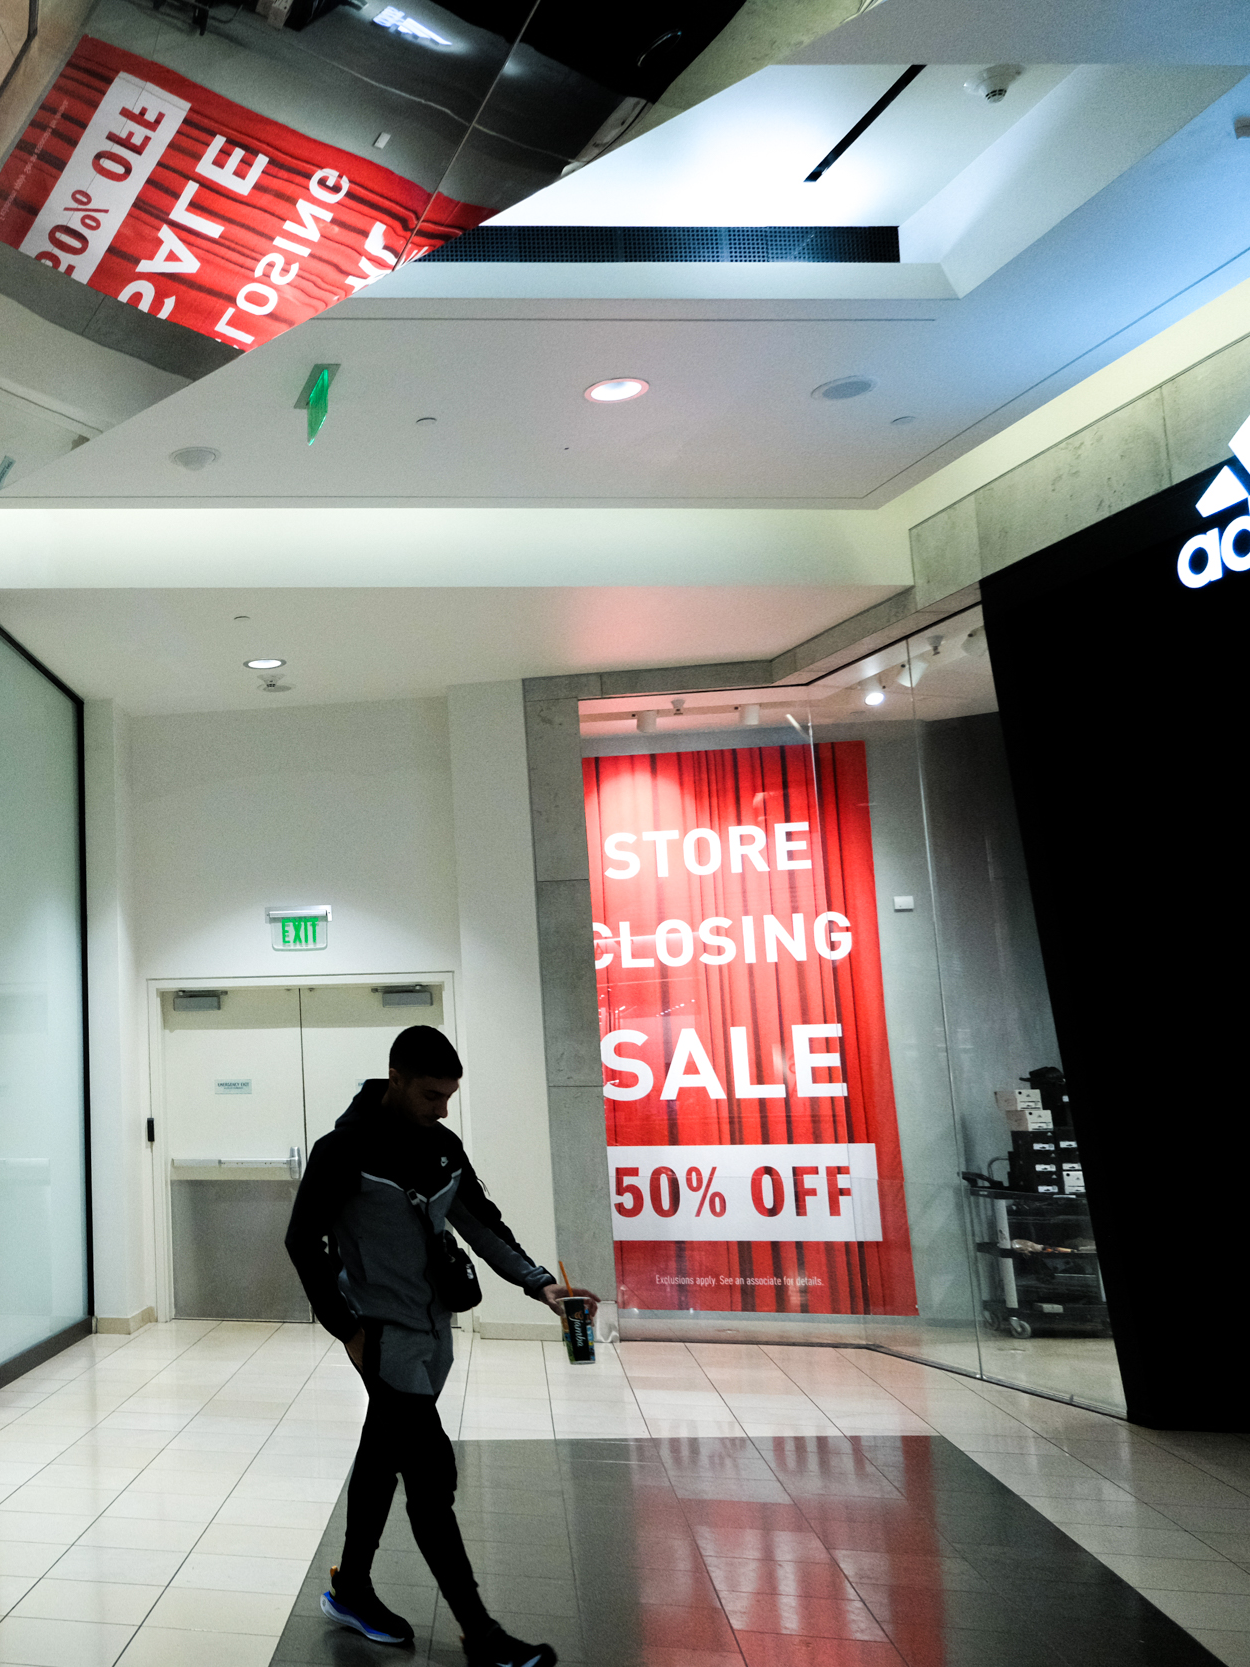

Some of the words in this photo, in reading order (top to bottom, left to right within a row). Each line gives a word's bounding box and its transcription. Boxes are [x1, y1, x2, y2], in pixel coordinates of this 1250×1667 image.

[604, 821, 813, 880] STORE
[281, 917, 319, 944] EXIT
[592, 911, 852, 970] CLOSING
[600, 1023, 848, 1102] SALE
[614, 1166, 727, 1219] 50%
[750, 1166, 852, 1217] OFF
[655, 1274, 694, 1285] Exclusions
[695, 1275, 718, 1287] apply.
[719, 1275, 734, 1285] See
[735, 1277, 745, 1285] an
[746, 1276, 782, 1286] associate
[783, 1276, 795, 1286] for
[796, 1276, 825, 1287] details.
[569, 1315, 587, 1347] jamba
